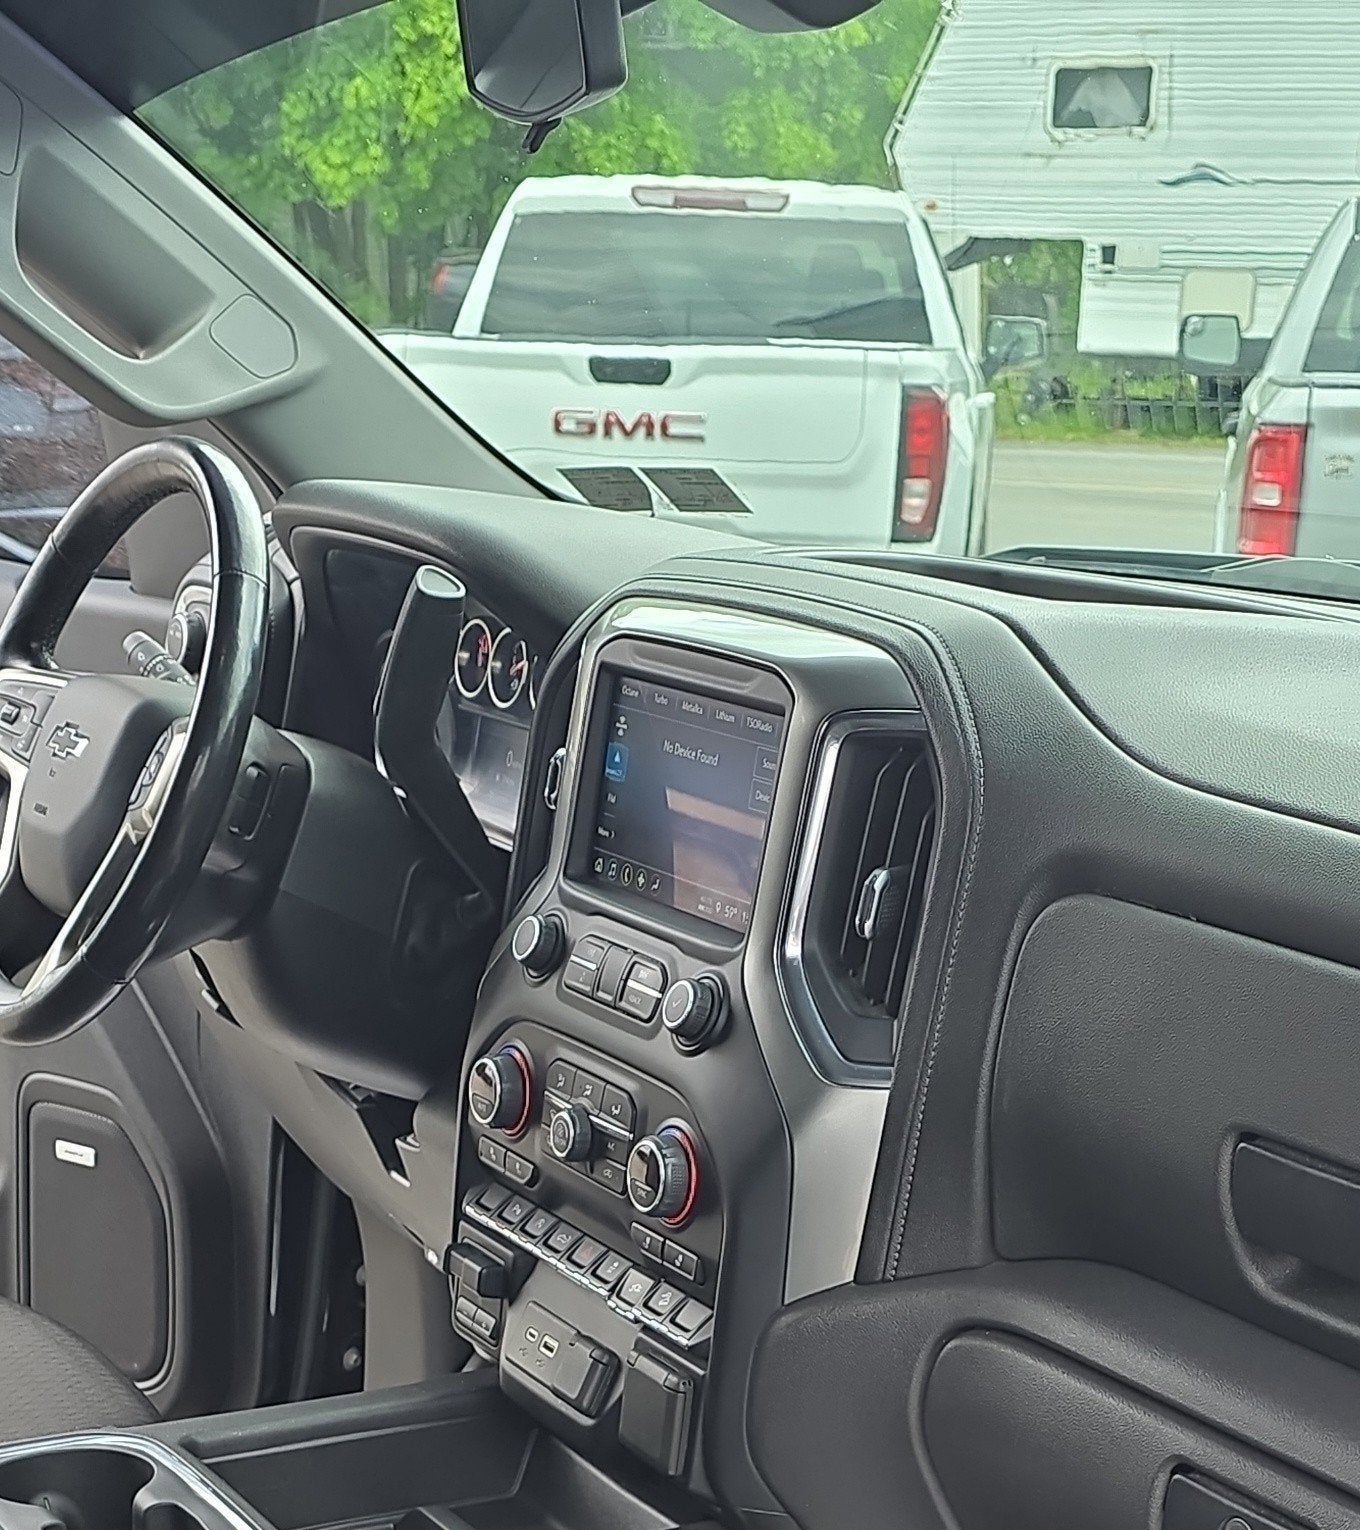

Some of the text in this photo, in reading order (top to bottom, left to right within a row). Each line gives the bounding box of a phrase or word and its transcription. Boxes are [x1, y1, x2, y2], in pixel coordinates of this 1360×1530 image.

[554, 408, 707, 442] GMC
[663, 738, 719, 767] No Device Found
